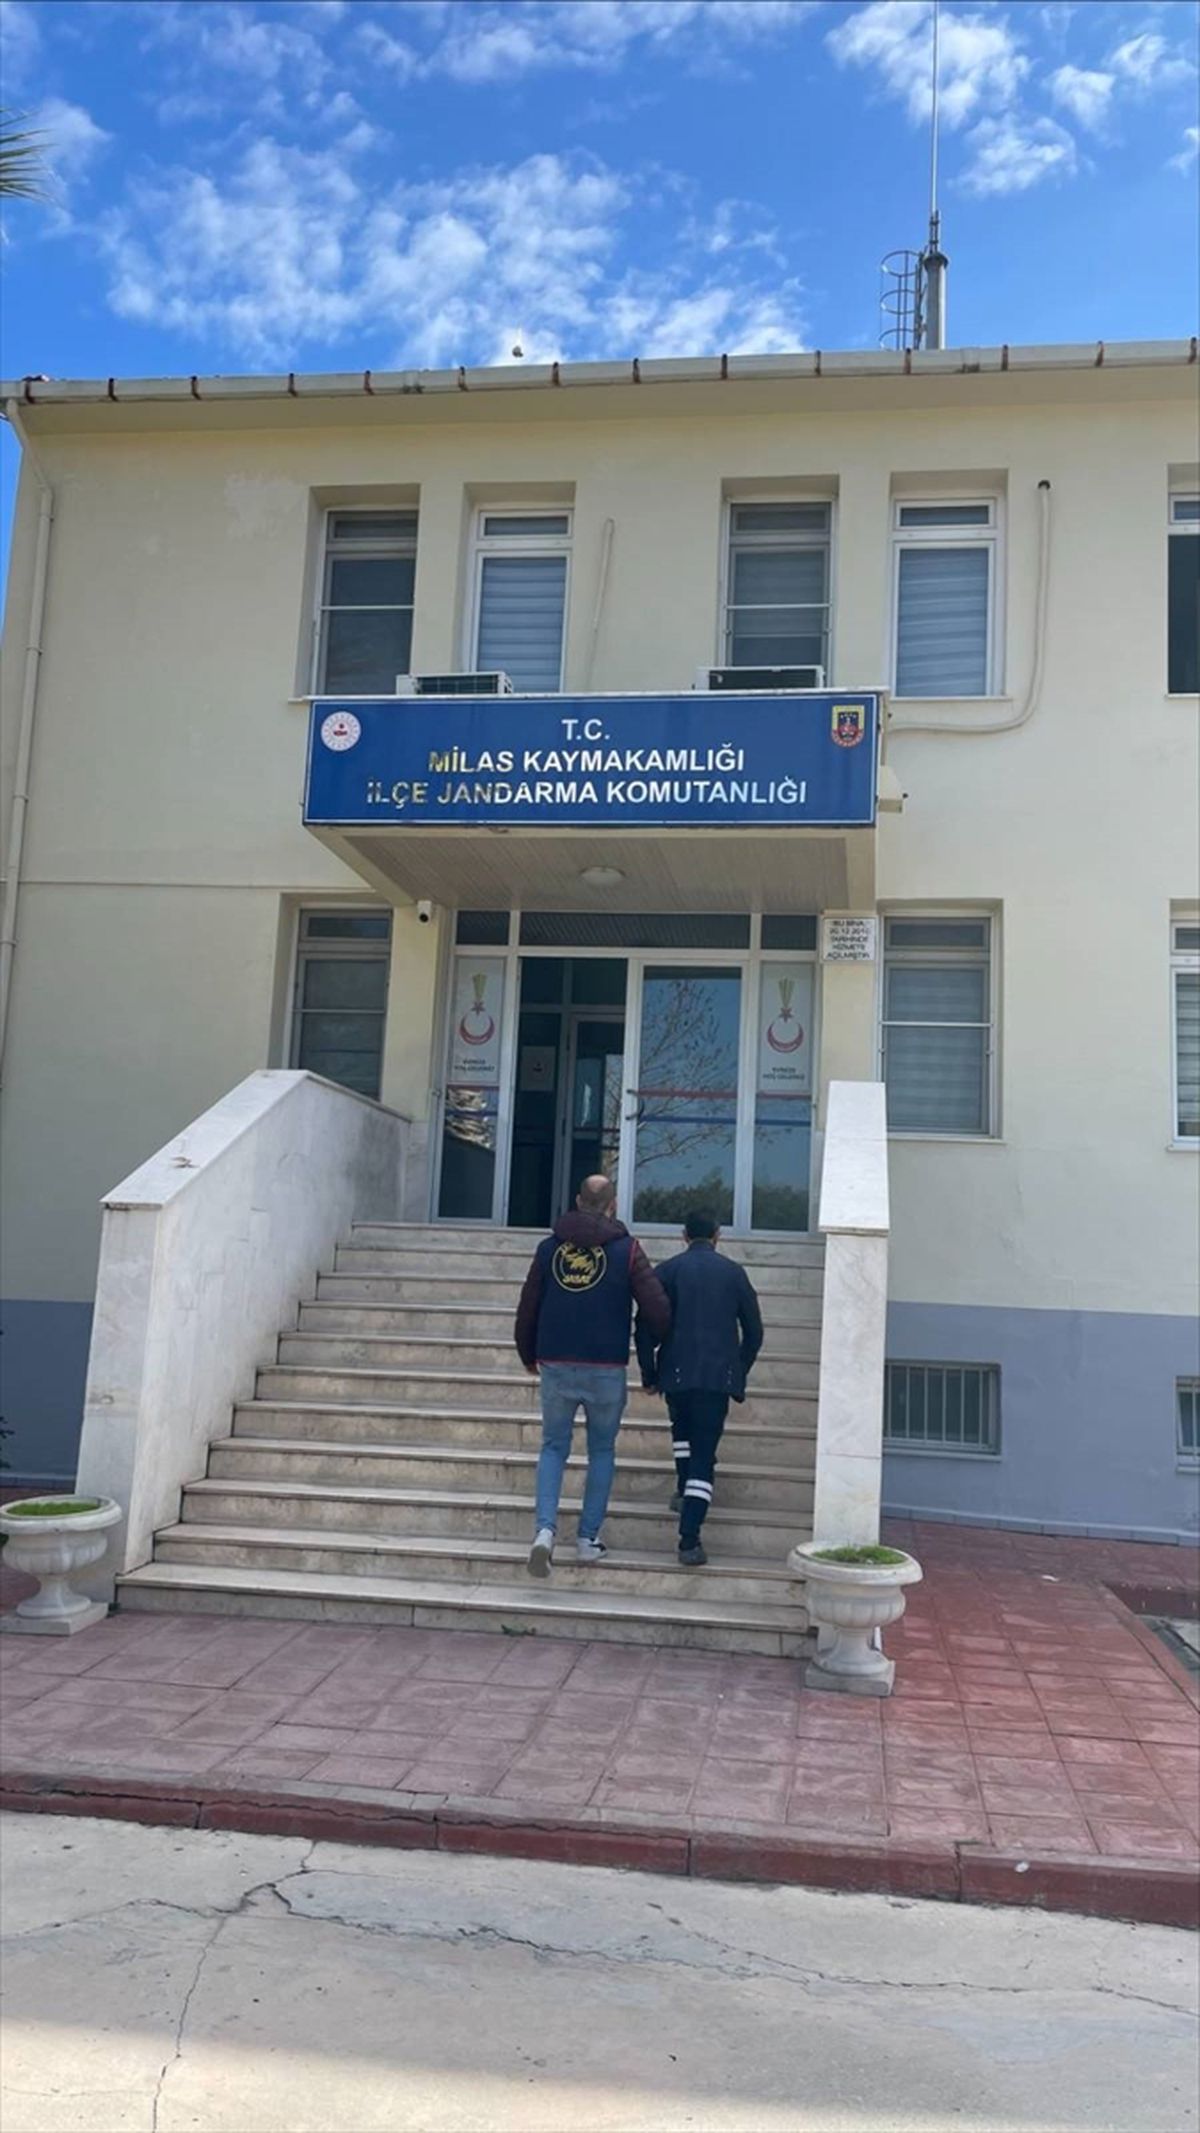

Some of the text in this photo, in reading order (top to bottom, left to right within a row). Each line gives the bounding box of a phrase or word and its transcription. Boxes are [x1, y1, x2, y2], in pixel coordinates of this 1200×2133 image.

[561, 718, 611, 741] T.C.
[428, 743, 744, 773] MİLAS KAYMAKAMLIĞI
[366, 776, 808, 809] İLÇE JANDARMA KOMUTANLIĞI
